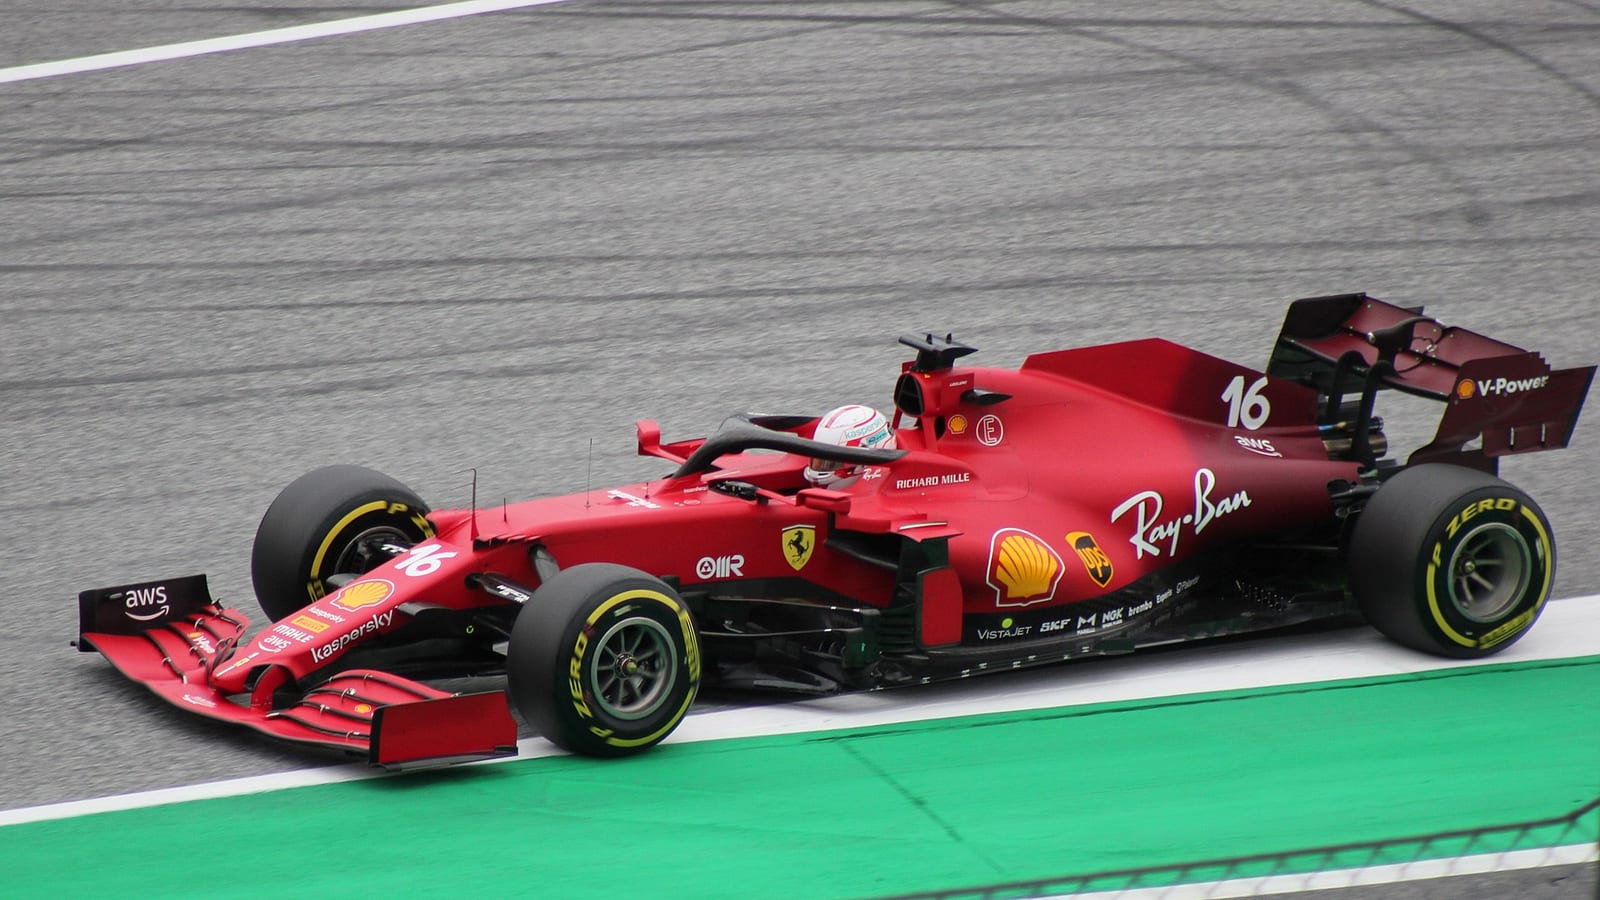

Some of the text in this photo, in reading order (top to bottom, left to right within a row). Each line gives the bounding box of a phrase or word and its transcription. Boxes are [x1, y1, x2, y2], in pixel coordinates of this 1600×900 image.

[1478, 376, 1549, 397] V-Power
[1221, 375, 1271, 431] 16
[1233, 435, 1275, 452] aws
[896, 472, 970, 489] RICHARD MILLE
[1445, 498, 1517, 540] ZERO
[394, 543, 457, 577] 16
[1077, 546, 1110, 578] ups
[125, 586, 168, 608] aws
[1040, 618, 1071, 633] SKF
[1102, 607, 1124, 623] NGK
[263, 634, 292, 649] aws
[272, 624, 315, 643] MAHLE
[311, 609, 394, 664] kaspersky
[569, 631, 593, 719] ZERO
